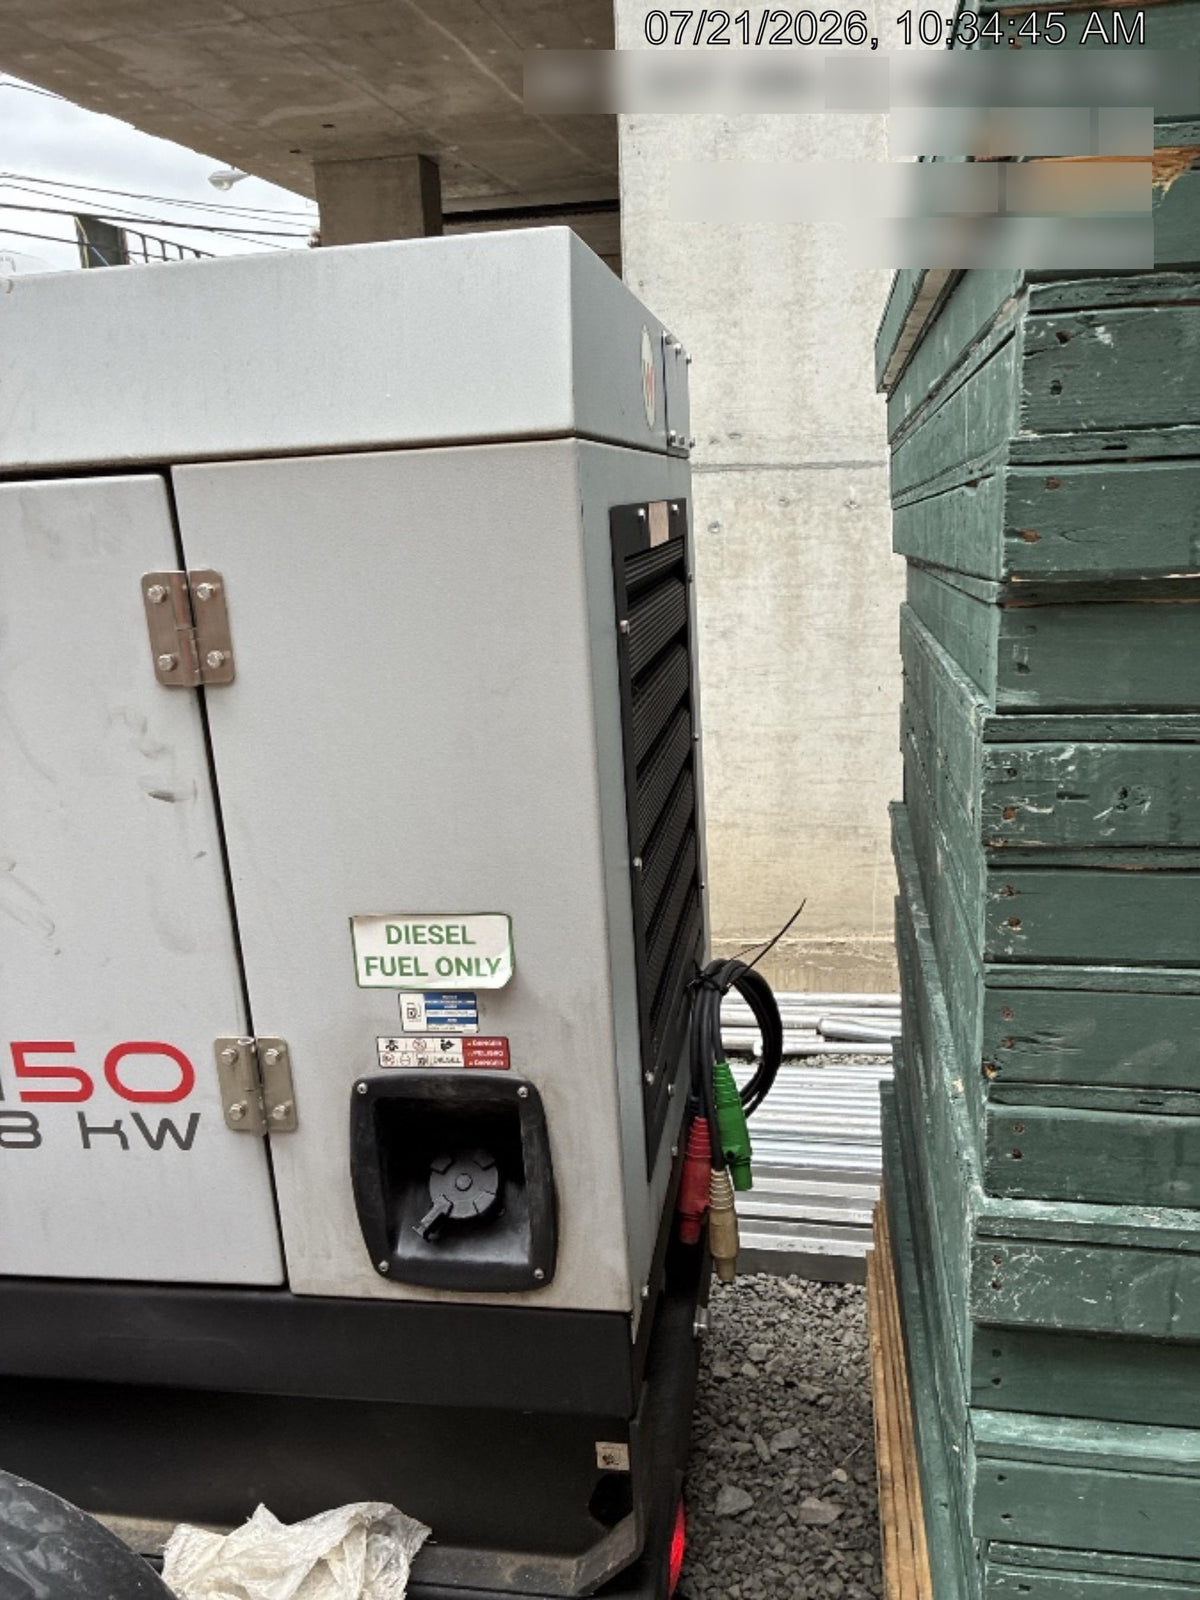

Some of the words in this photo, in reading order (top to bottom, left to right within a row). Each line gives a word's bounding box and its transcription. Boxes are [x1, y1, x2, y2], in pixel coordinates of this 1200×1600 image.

[385, 924, 477, 945] DIESEL
[364, 956, 429, 977] FUEL
[435, 956, 502, 978] ONLY
[0, 1041, 195, 1103] 50
